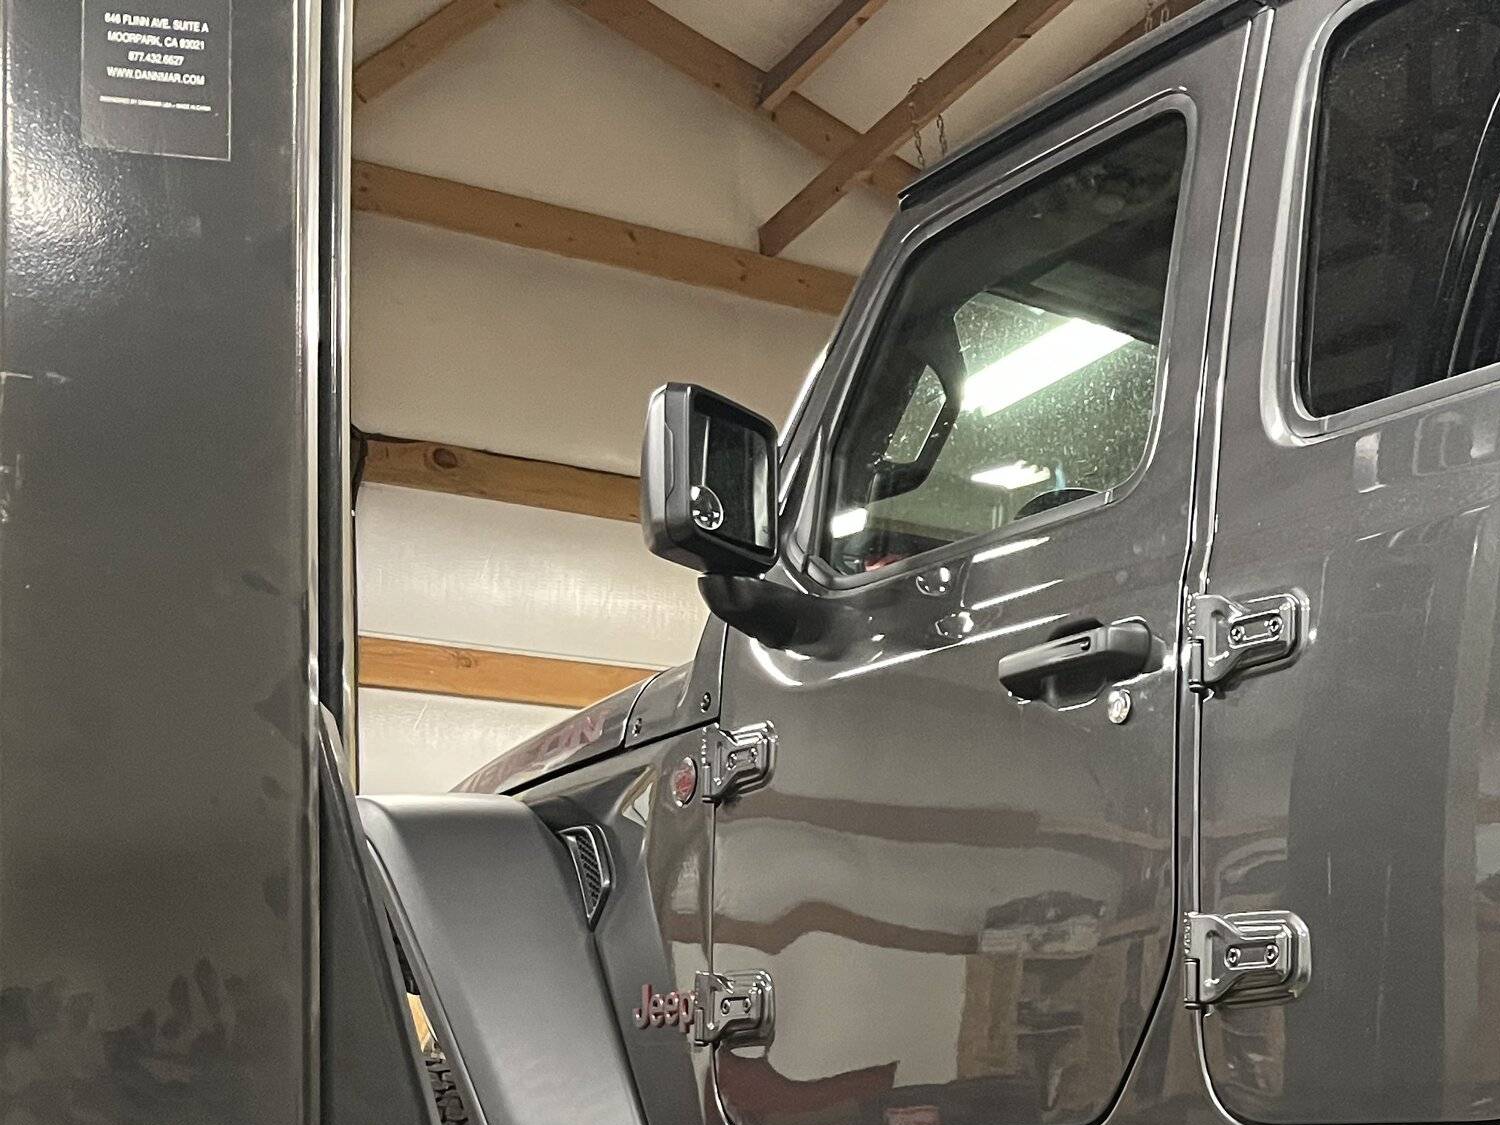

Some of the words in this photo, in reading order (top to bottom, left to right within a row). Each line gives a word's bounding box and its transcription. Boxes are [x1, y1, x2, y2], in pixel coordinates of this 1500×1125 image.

[172, 19, 200, 32] SUITE
[201, 23, 209, 33] A
[163, 37, 178, 49] CA
[634, 984, 698, 1033] Jeep
